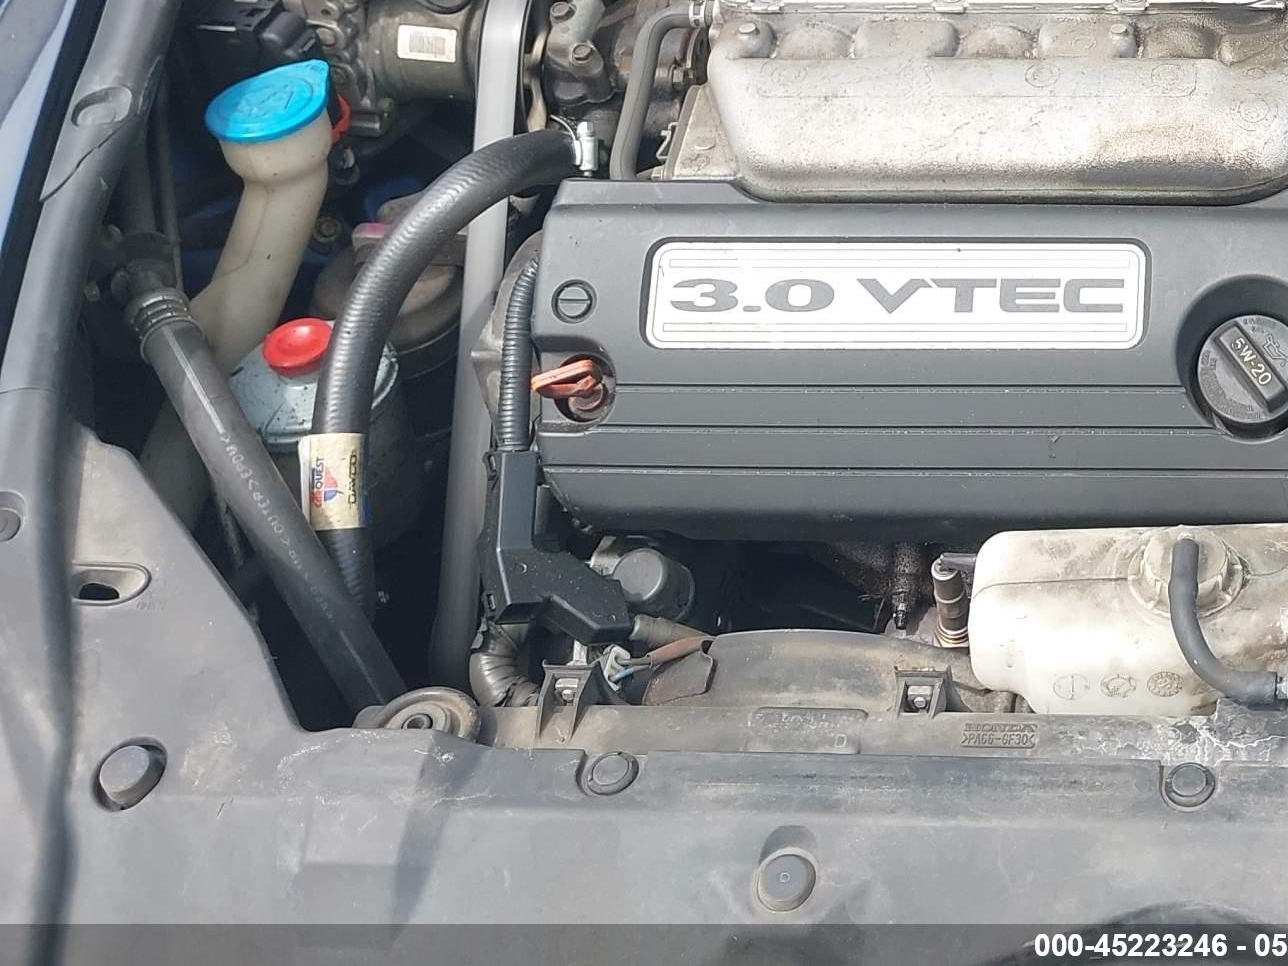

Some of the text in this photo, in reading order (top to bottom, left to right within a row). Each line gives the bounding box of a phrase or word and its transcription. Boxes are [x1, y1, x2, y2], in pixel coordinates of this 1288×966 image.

[670, 278, 1124, 314] 3.0 VTEC
[1229, 337, 1272, 385] 5W-20
[347, 454, 357, 504] DAYCO
